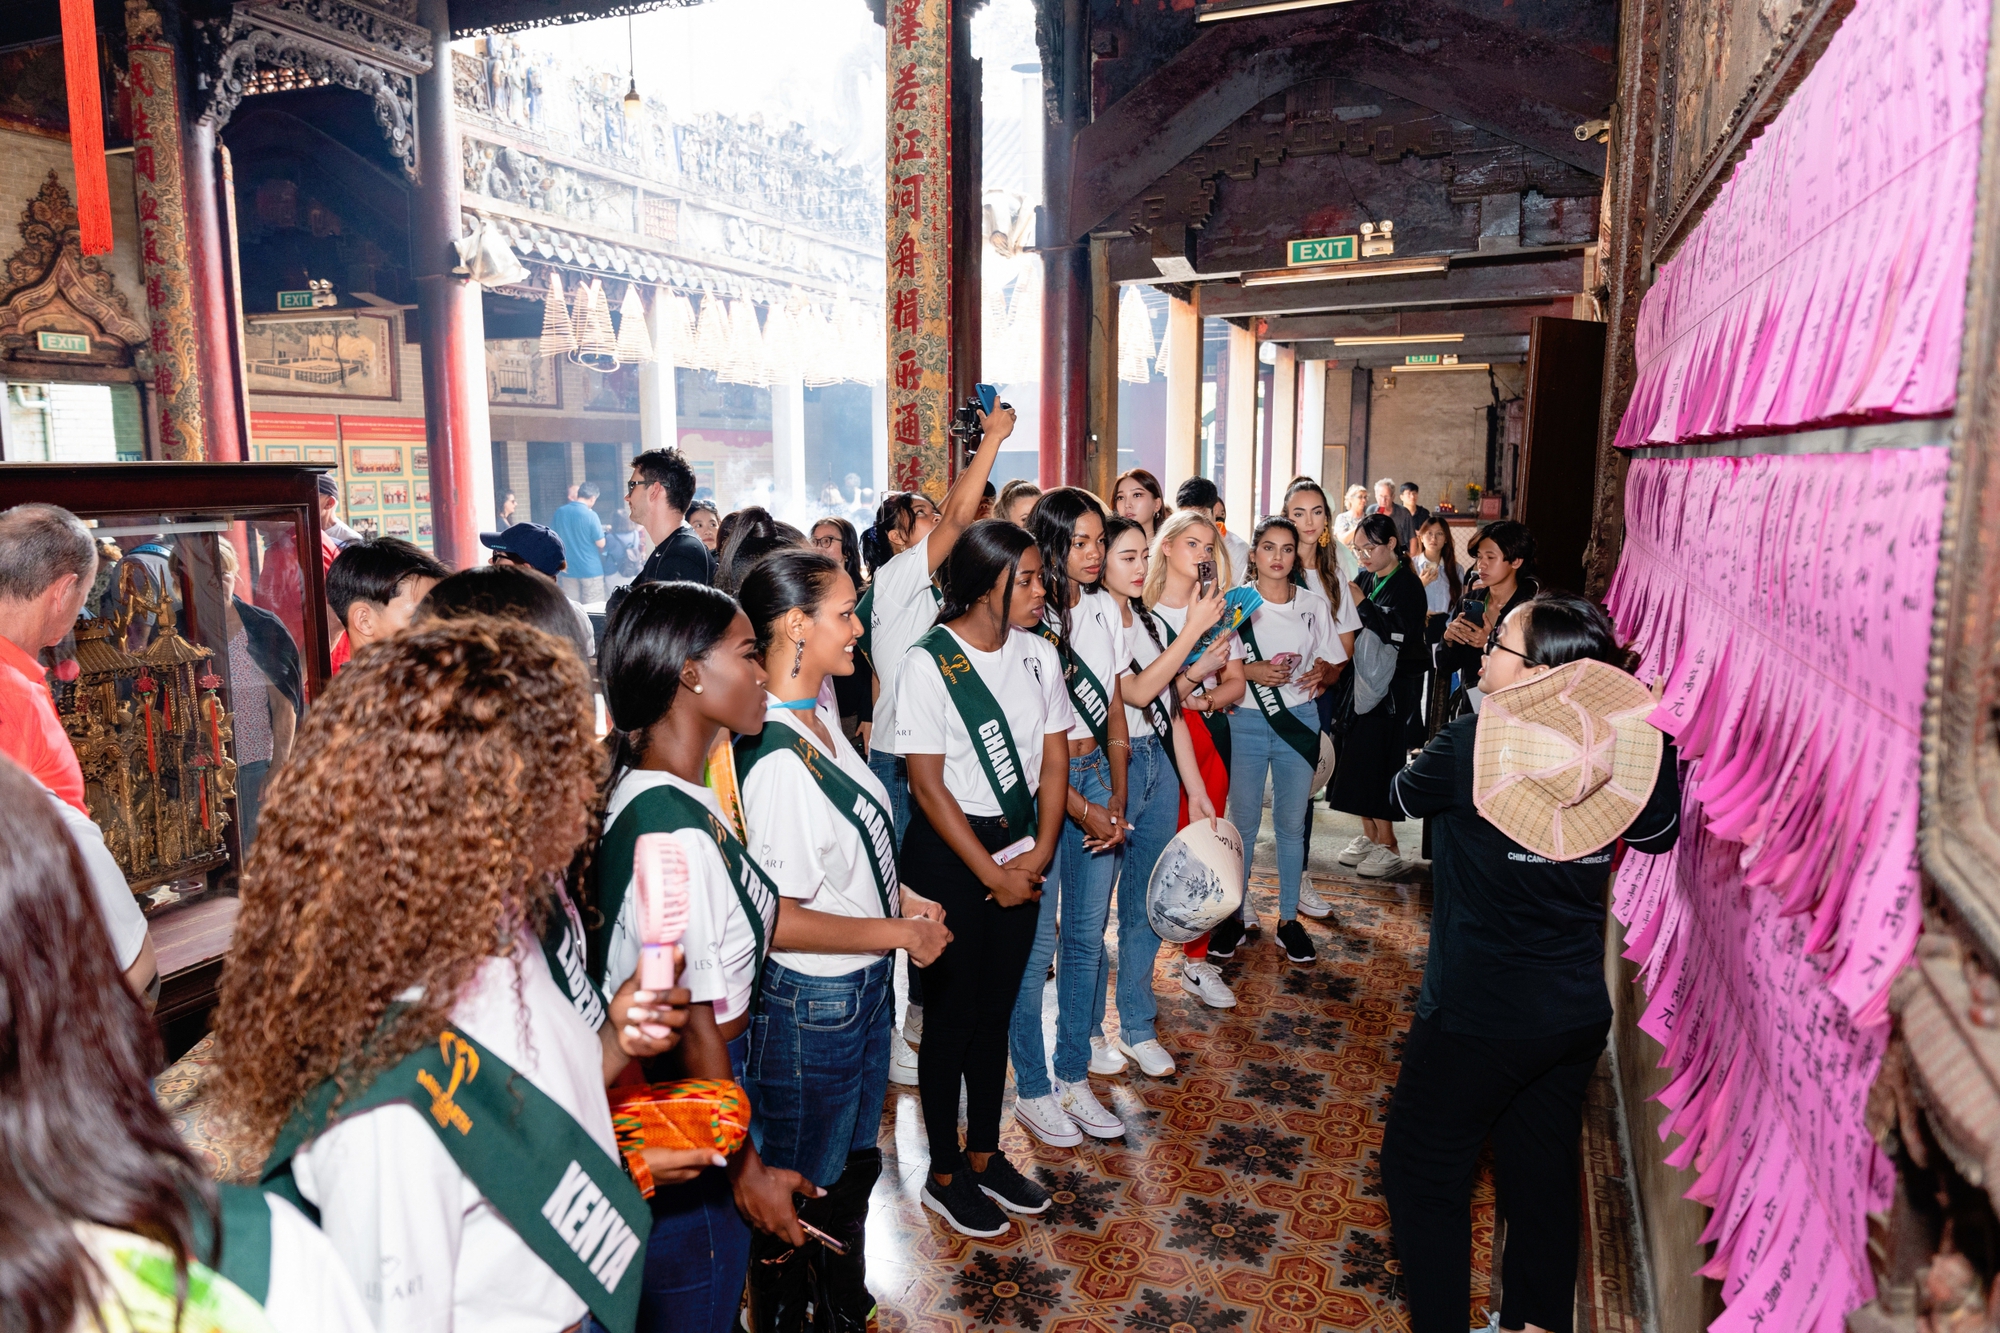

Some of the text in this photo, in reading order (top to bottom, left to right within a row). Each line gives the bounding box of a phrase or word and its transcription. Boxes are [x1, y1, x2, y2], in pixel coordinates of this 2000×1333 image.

[1300, 241, 1347, 260] EXIT
[284, 294, 310, 307] EXIT
[47, 336, 82, 350] EXIT
[1243, 642, 1257, 664] SR
[1073, 677, 1108, 728] HAITI
[978, 719, 1019, 795] GHANA
[763, 859, 785, 869] ART
[1507, 851, 1527, 862] CHIM
[694, 958, 713, 970] LES
[556, 926, 607, 1034] LIBERI
[541, 1159, 641, 1294] KENYA
